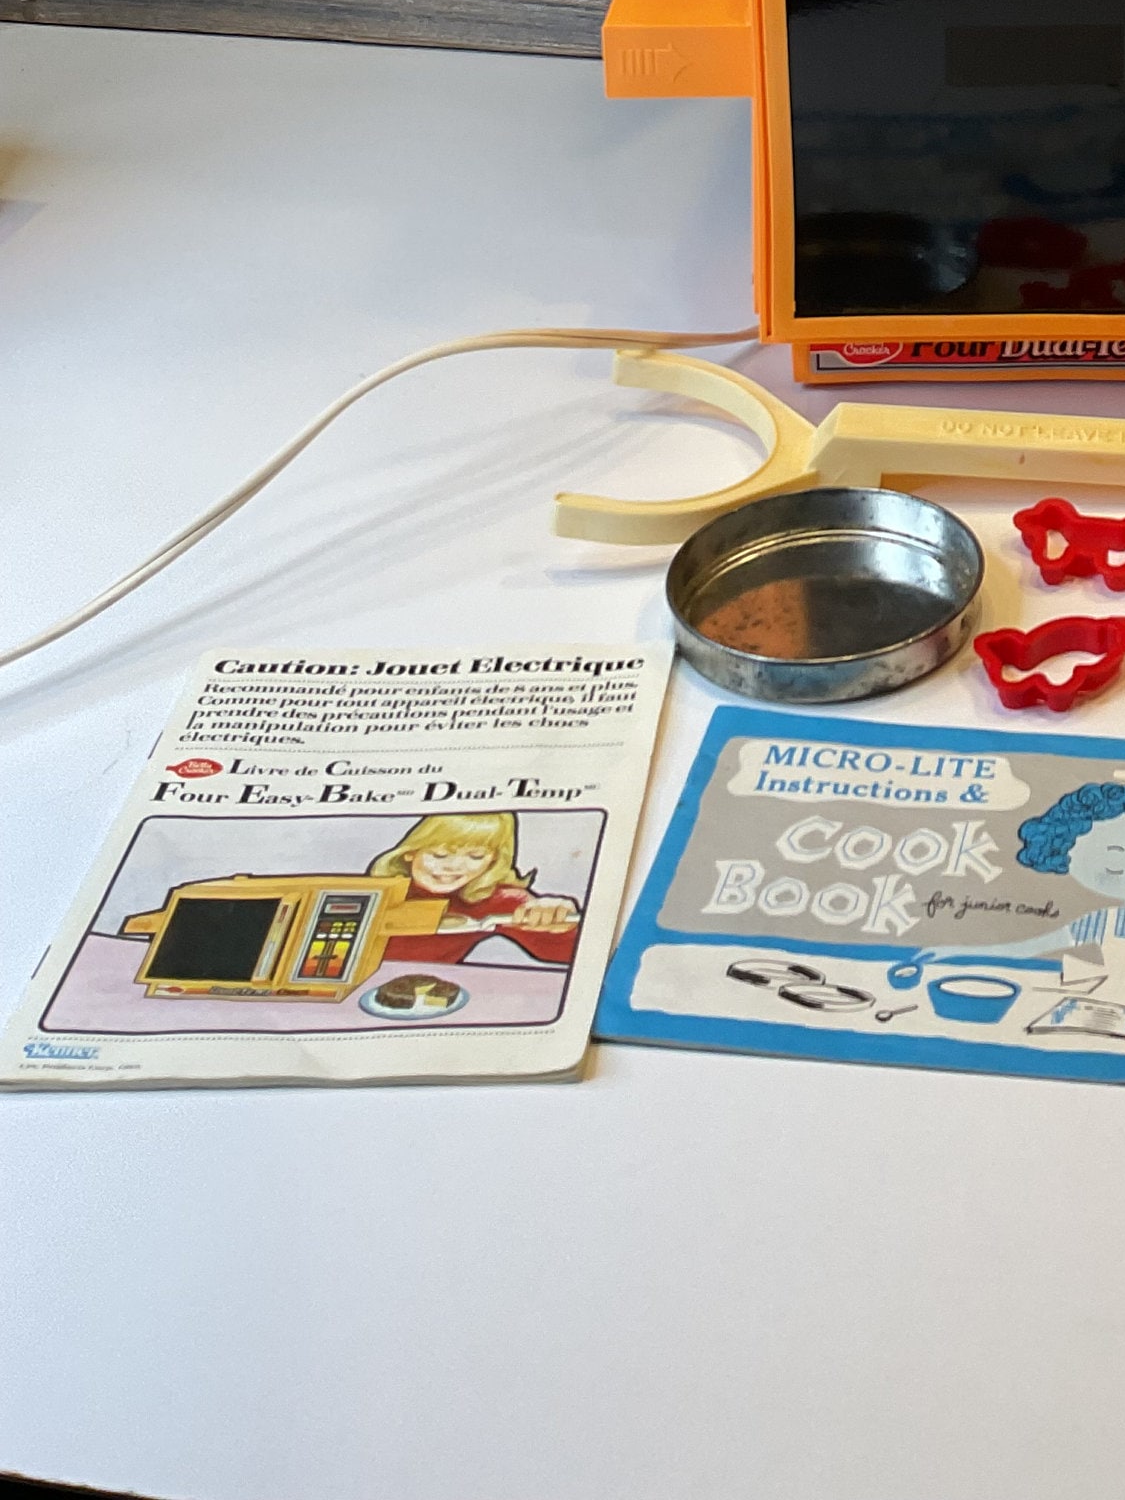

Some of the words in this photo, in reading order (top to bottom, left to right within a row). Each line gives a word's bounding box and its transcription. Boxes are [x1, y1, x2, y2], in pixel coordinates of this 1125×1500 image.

[939, 420, 973, 436] DO
[981, 424, 1025, 438] NOT
[1033, 425, 1111, 444] LEAVE
[213, 658, 360, 676] Caution:
[365, 658, 462, 676] Jouet
[468, 656, 645, 677] Electrique
[203, 683, 347, 696] Recommandé
[349, 685, 403, 698] pour
[404, 684, 481, 696] enfants
[484, 683, 511, 694] de
[514, 683, 526, 694] 8
[529, 684, 565, 694] ans
[568, 682, 587, 693] et
[179, 731, 306, 746] électriques.
[227, 758, 290, 776] Livre
[294, 766, 319, 776] de
[325, 760, 412, 777] Cuisson
[418, 763, 443, 775] du
[762, 744, 996, 780] MICRO-LITE
[149, 781, 230, 804] Four
[754, 769, 948, 804] Instructions
[959, 783, 989, 804] &
[923, 890, 955, 917] for
[958, 895, 1013, 920] junior
[1015, 900, 1060, 919] cooks
